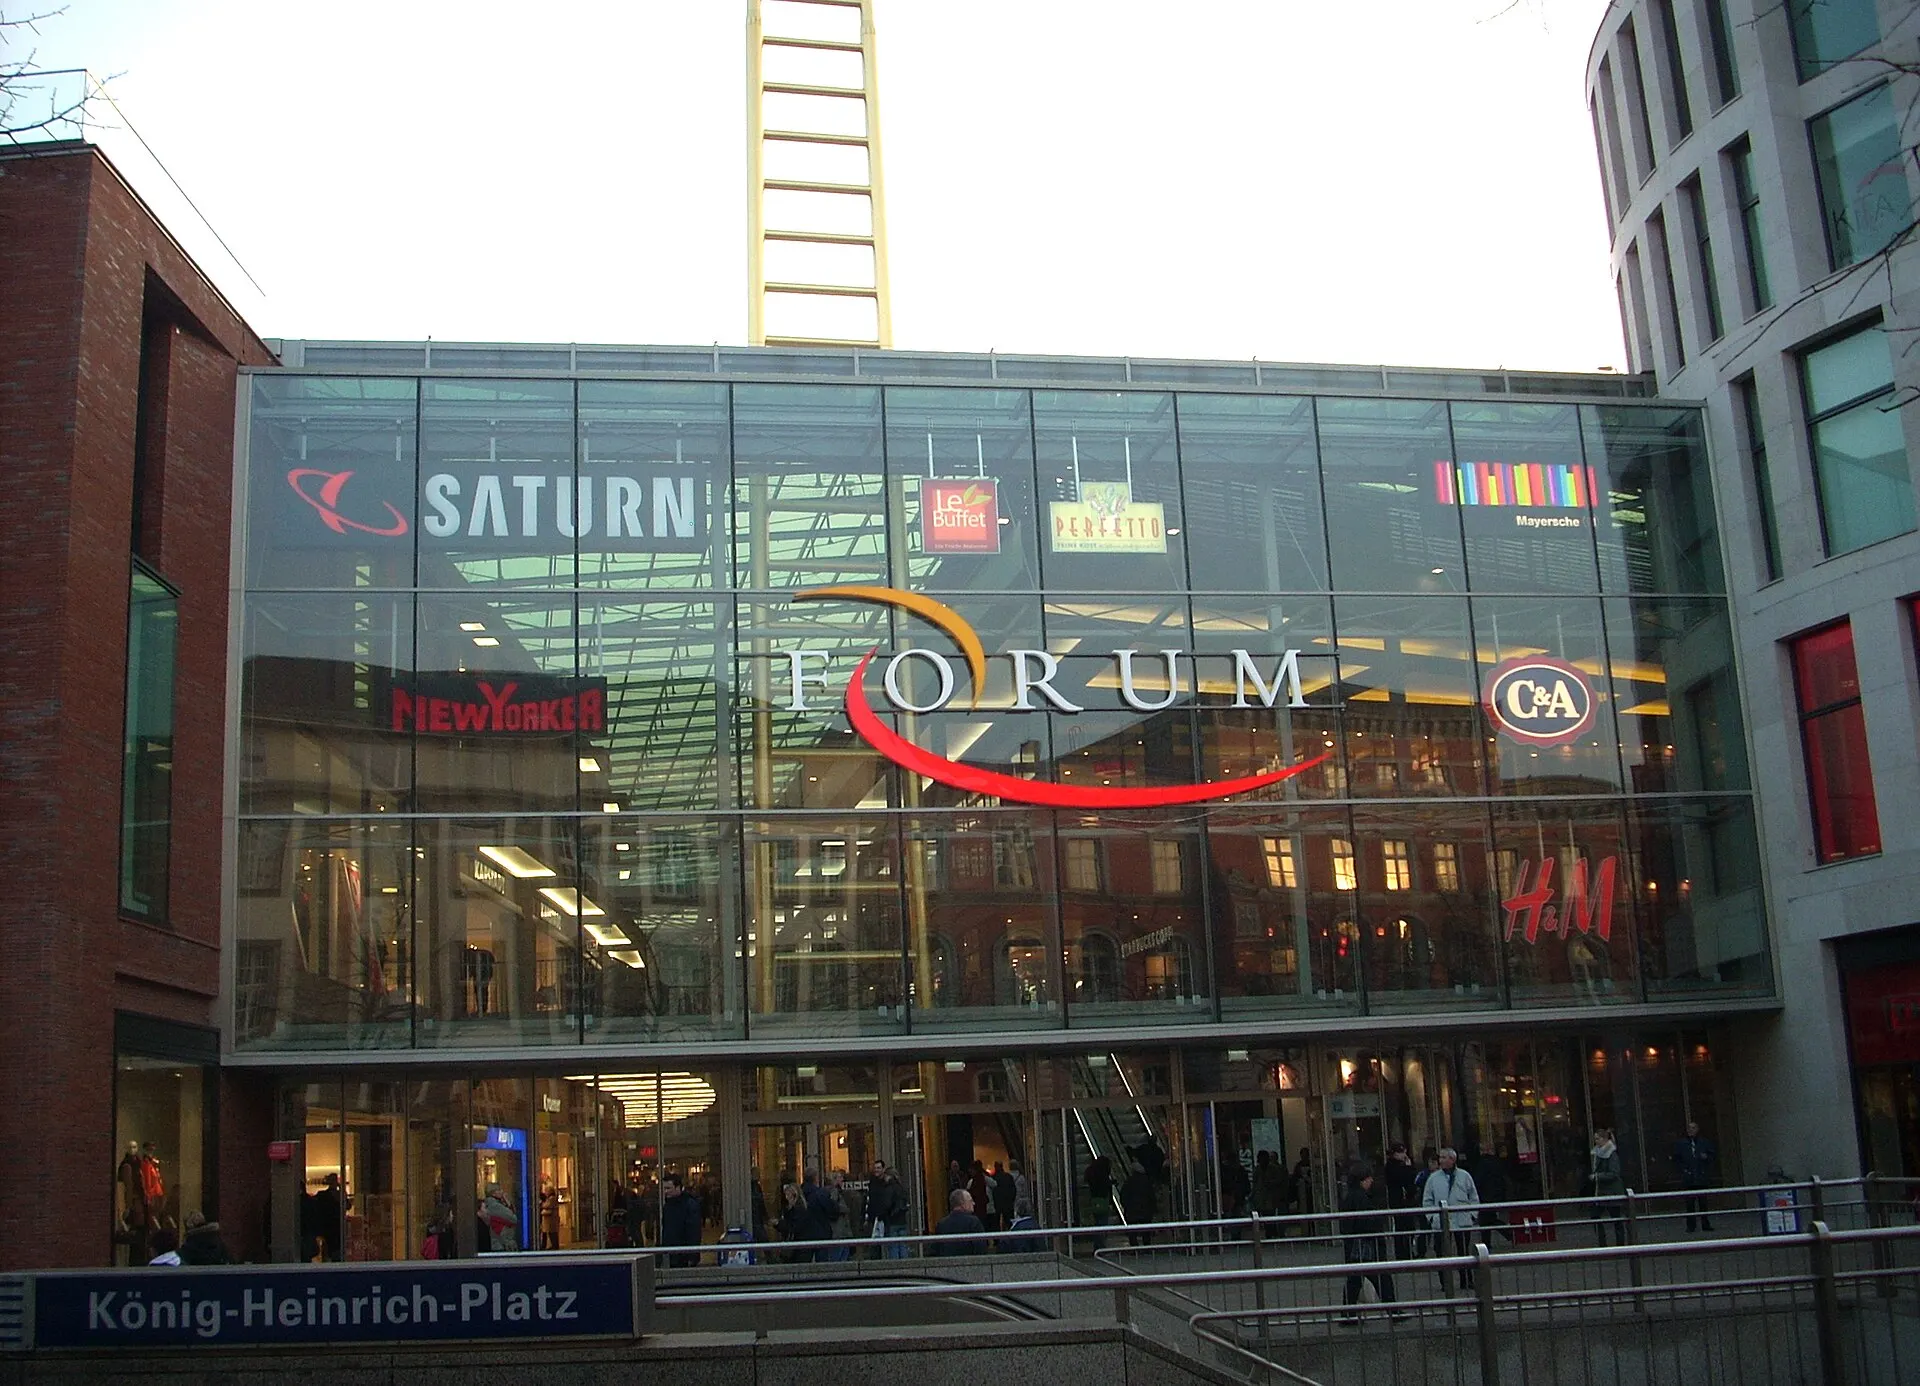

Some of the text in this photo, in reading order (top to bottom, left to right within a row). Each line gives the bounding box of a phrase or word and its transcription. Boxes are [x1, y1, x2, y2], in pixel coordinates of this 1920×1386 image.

[424, 473, 696, 538] SATURN
[932, 509, 987, 528] Buffet
[935, 488, 963, 513] Le
[1055, 516, 1161, 538] PERFETTO
[1516, 515, 1580, 528] Mayersche
[785, 649, 1311, 714] FORUM
[1506, 680, 1579, 719] C&A
[1502, 855, 1618, 945] H&M
[88, 1282, 579, 1337] König-Heinrich-Platz
